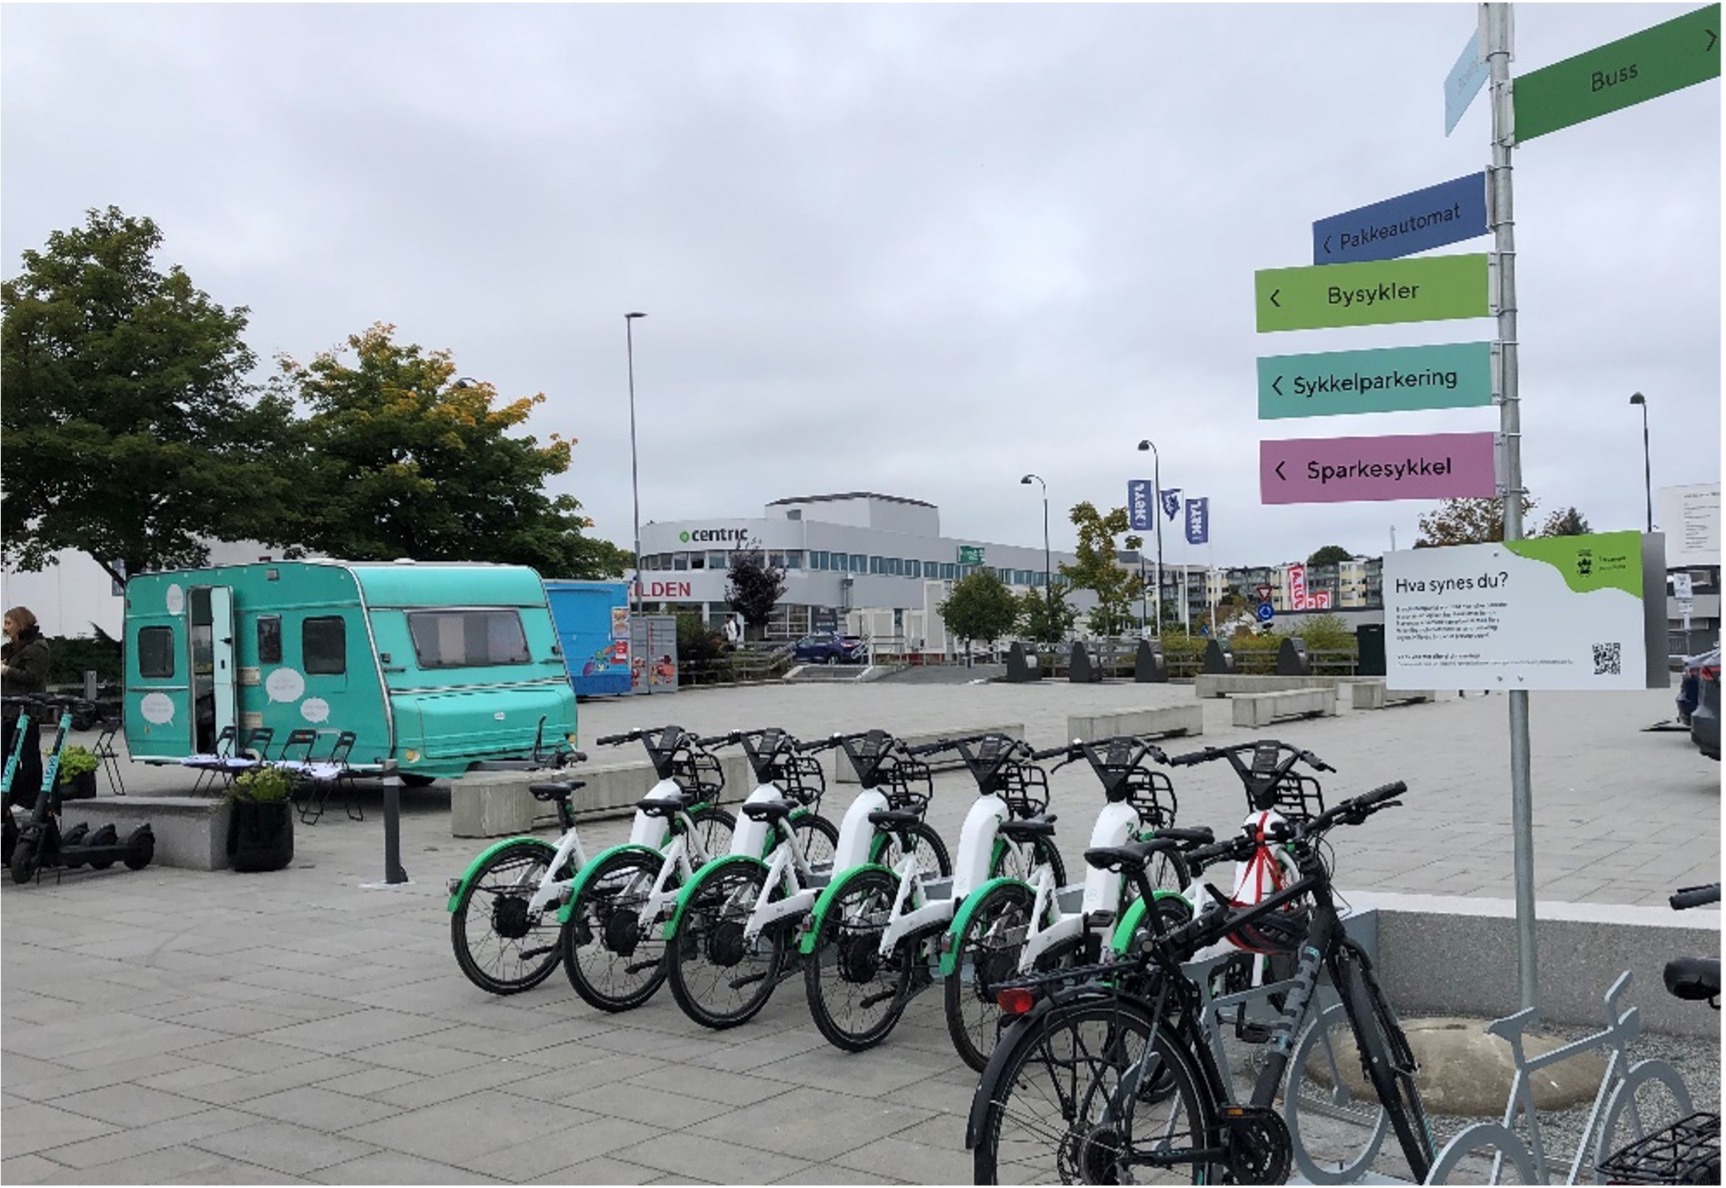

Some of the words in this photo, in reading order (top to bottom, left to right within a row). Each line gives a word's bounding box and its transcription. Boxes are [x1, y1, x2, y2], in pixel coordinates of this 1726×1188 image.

[1590, 64, 1639, 92] Buss
[1340, 203, 1461, 250] Pakkeautomat
[1328, 283, 1420, 307] Bysykler
[1294, 369, 1458, 397] Sykkelparkering
[1307, 457, 1452, 484] Sparkesykkel
[692, 528, 748, 542] centric
[628, 581, 691, 597] ILDEN
[1396, 578, 1425, 594] Hva
[1429, 578, 1474, 595] synes
[1477, 571, 1509, 589] du?
